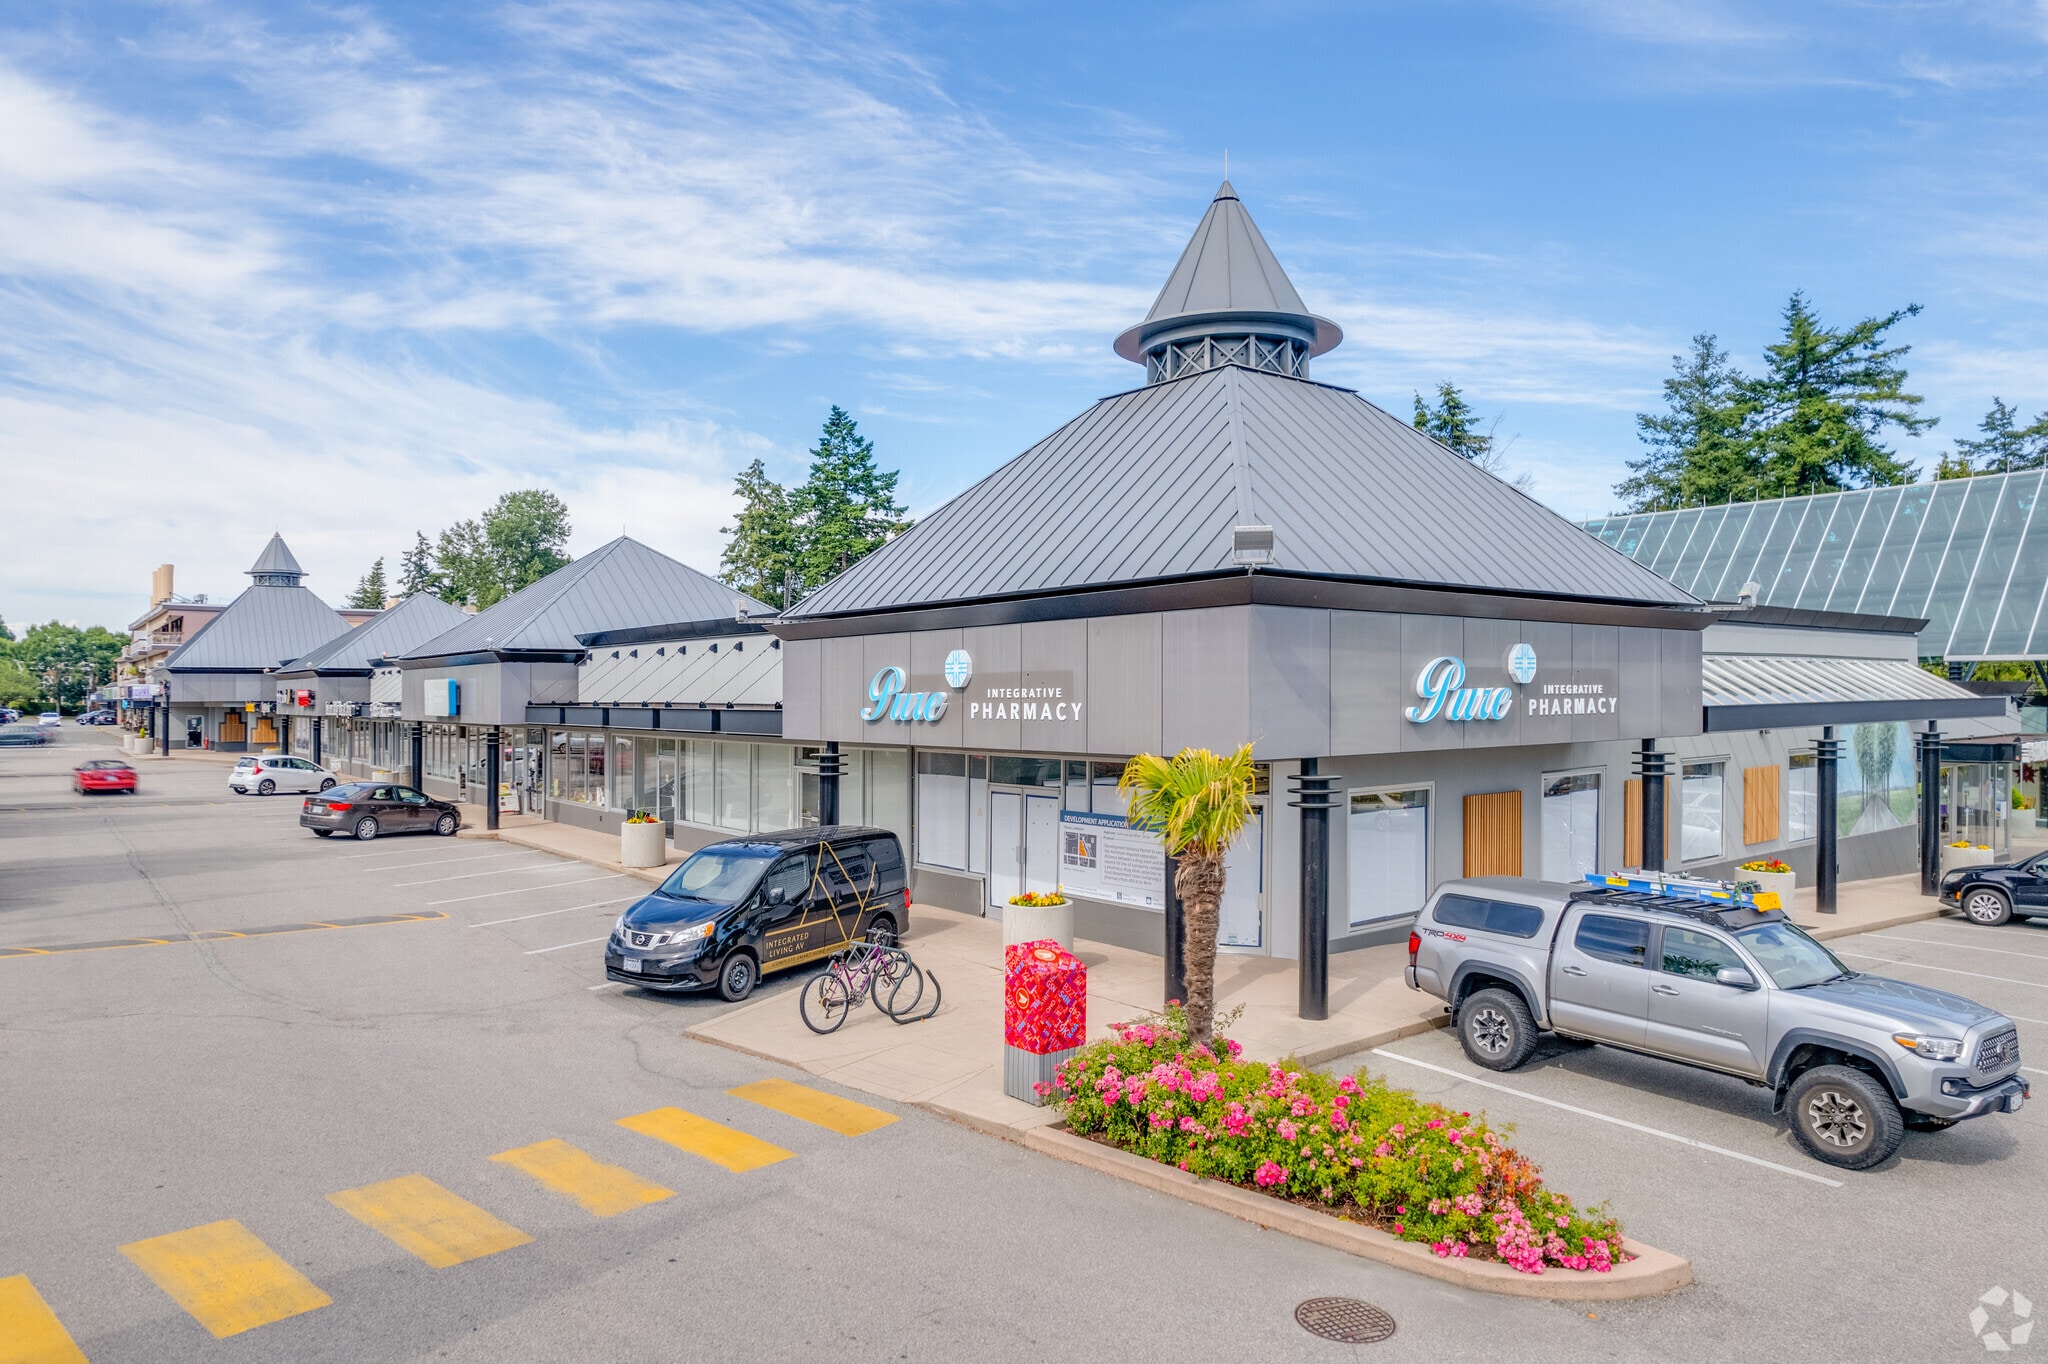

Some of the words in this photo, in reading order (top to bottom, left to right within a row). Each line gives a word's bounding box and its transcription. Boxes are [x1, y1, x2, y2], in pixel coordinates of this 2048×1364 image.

[861, 666, 948, 721] Pure
[987, 688, 1062, 699] INTEGRATIVE
[1405, 656, 1512, 723] Pure
[1543, 684, 1603, 695] INTEGRATIVE
[970, 702, 1082, 721] PHARMACY
[1528, 697, 1617, 716] PHARMACY
[1064, 815, 1098, 825] DEVELOPMENT
[1098, 819, 1129, 829] APPLICATION
[765, 932, 809, 950] INTEGRATED
[769, 944, 793, 958] LIVING
[795, 942, 805, 951] AV
[772, 956, 796, 967] COMPLETE
[797, 952, 813, 960] SMART
